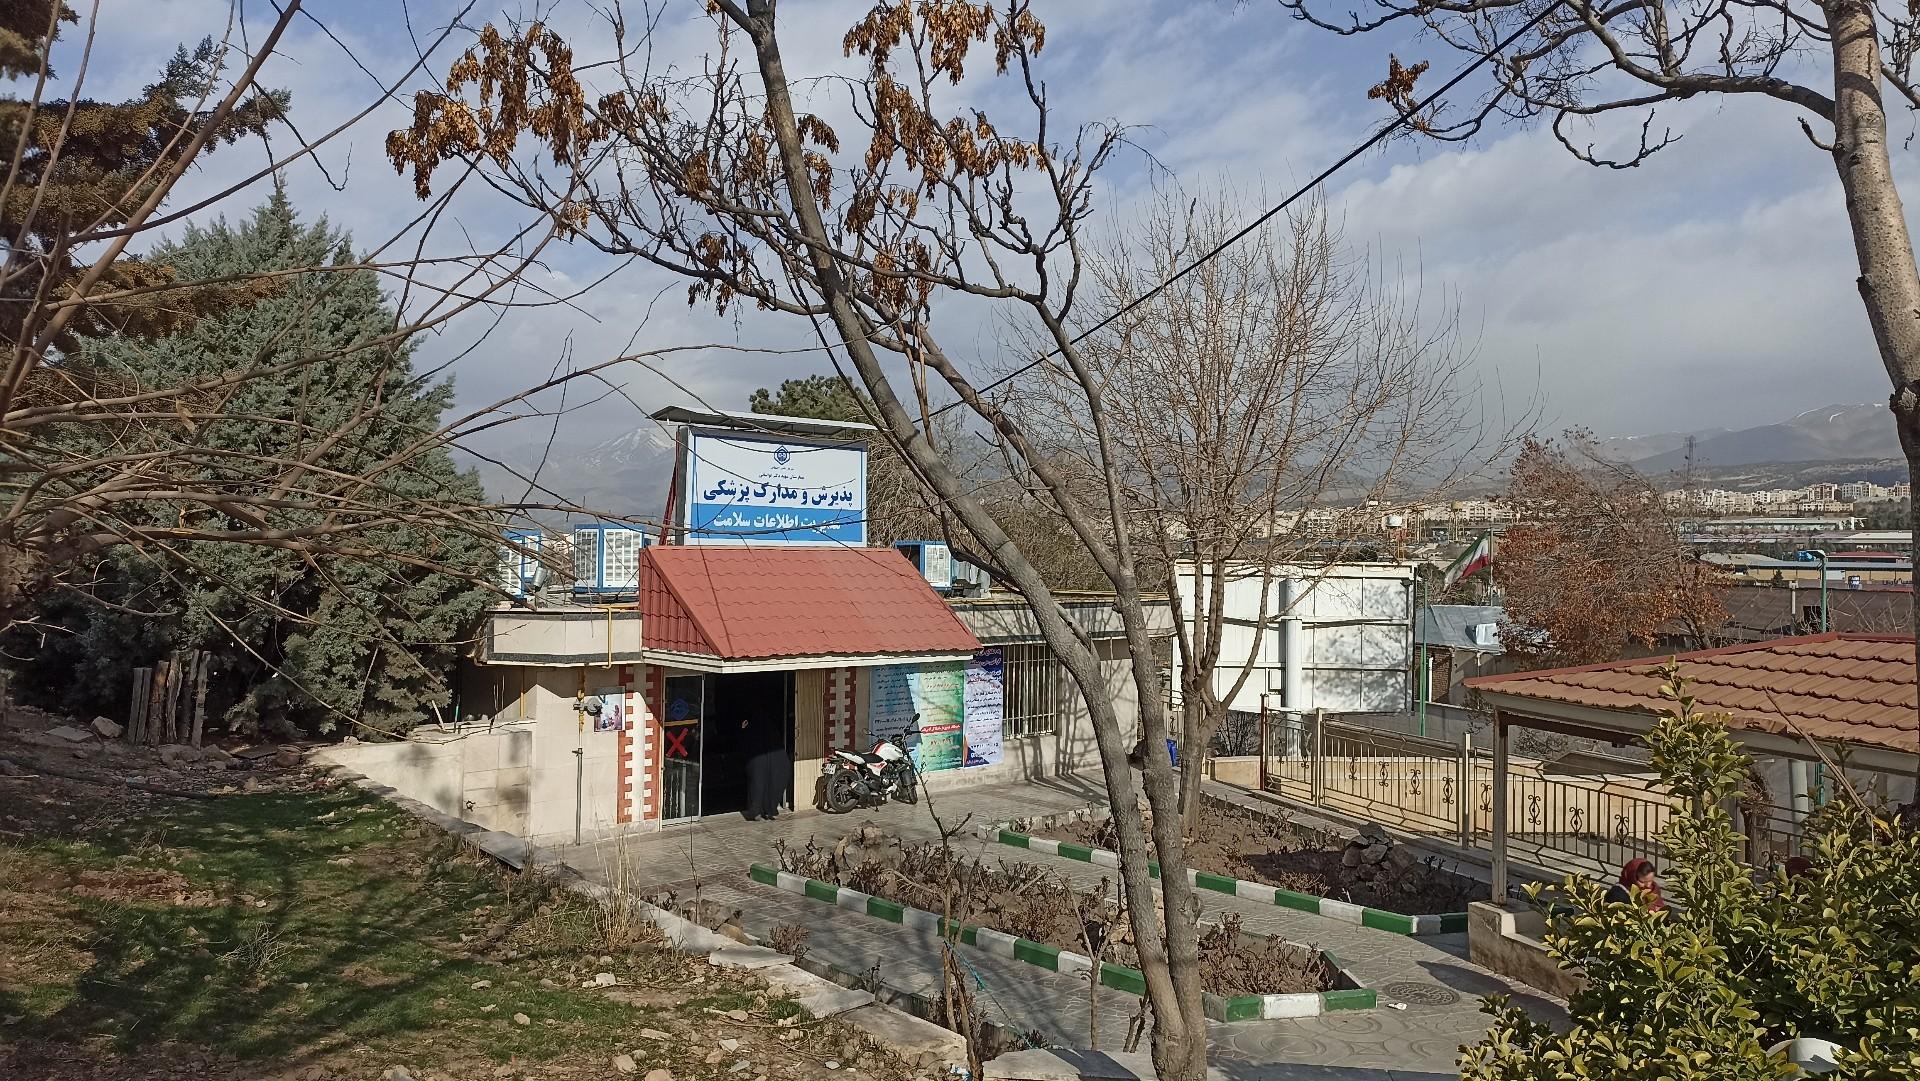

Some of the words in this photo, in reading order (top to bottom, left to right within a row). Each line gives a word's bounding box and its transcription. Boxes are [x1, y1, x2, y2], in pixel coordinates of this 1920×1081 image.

[703, 479, 750, 502] پزشکی
[753, 482, 797, 503] مدارک
[801, 490, 808, 505] و
[811, 485, 853, 507] پذیرش
[713, 511, 751, 527] سلامت
[753, 513, 798, 528] اطلاعات
